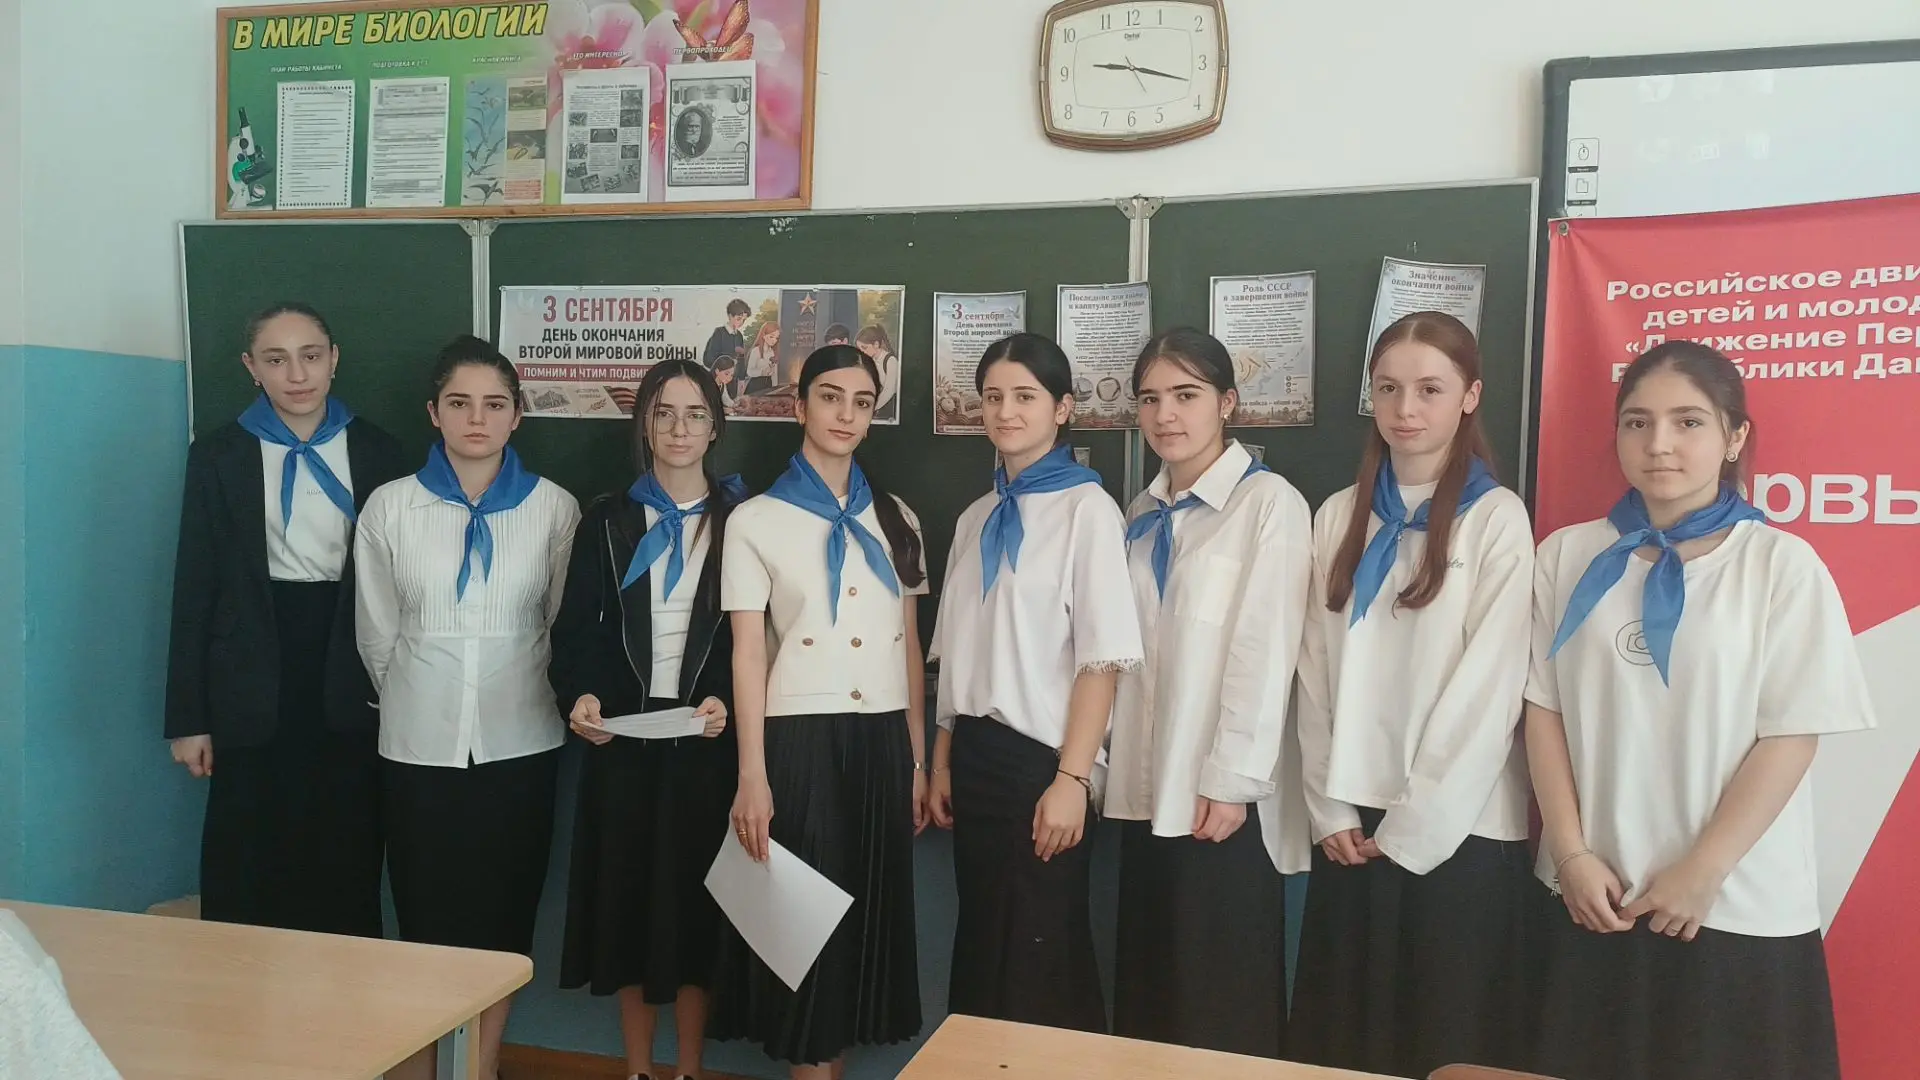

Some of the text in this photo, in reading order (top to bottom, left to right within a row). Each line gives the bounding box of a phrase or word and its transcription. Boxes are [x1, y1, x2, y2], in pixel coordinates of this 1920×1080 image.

[1100, 14, 1112, 30] 11
[1125, 9, 1140, 26] 12
[1158, 9, 1163, 25] 1
[1193, 15, 1203, 32] 2
[233, 2, 549, 50] В МИРЕ БИОЛОГИИ
[1063, 28, 1076, 43] 10
[287, 64, 311, 72] РАБОТЫ
[1198, 54, 1207, 71] 3
[1060, 65, 1069, 82] 9
[1193, 94, 1201, 111] 4
[1064, 104, 1073, 120] 8
[1100, 111, 1109, 127] 7
[1127, 110, 1136, 127] 6
[1155, 107, 1164, 124] 5
[1391, 278, 1475, 291] окончания войны
[1408, 270, 1457, 282] Значение
[1242, 283, 1292, 293] Роль СССР
[1606, 269, 1842, 301] Российское
[1230, 293, 1282, 302] завершении
[1284, 290, 1309, 298] войны
[543, 295, 673, 323] 3 СЕНТЯБРЯ
[951, 302, 1005, 320] 3 сентября
[1642, 299, 1755, 330] детей
[1764, 303, 1788, 321] и
[541, 328, 664, 343] ДЕНЬ ОКОНЧАНИЯ
[971, 329, 1001, 337] мировой
[1624, 322, 1920, 354] «Дижение Пе
[519, 343, 697, 360] ВТОРОЙ МИРОВОЙ ВОЙНЫ
[524, 367, 567, 377] ПОМНИМ
[570, 367, 577, 377] И
[579, 367, 607, 378] ЧТИМ
[1853, 352, 1920, 380] Да
